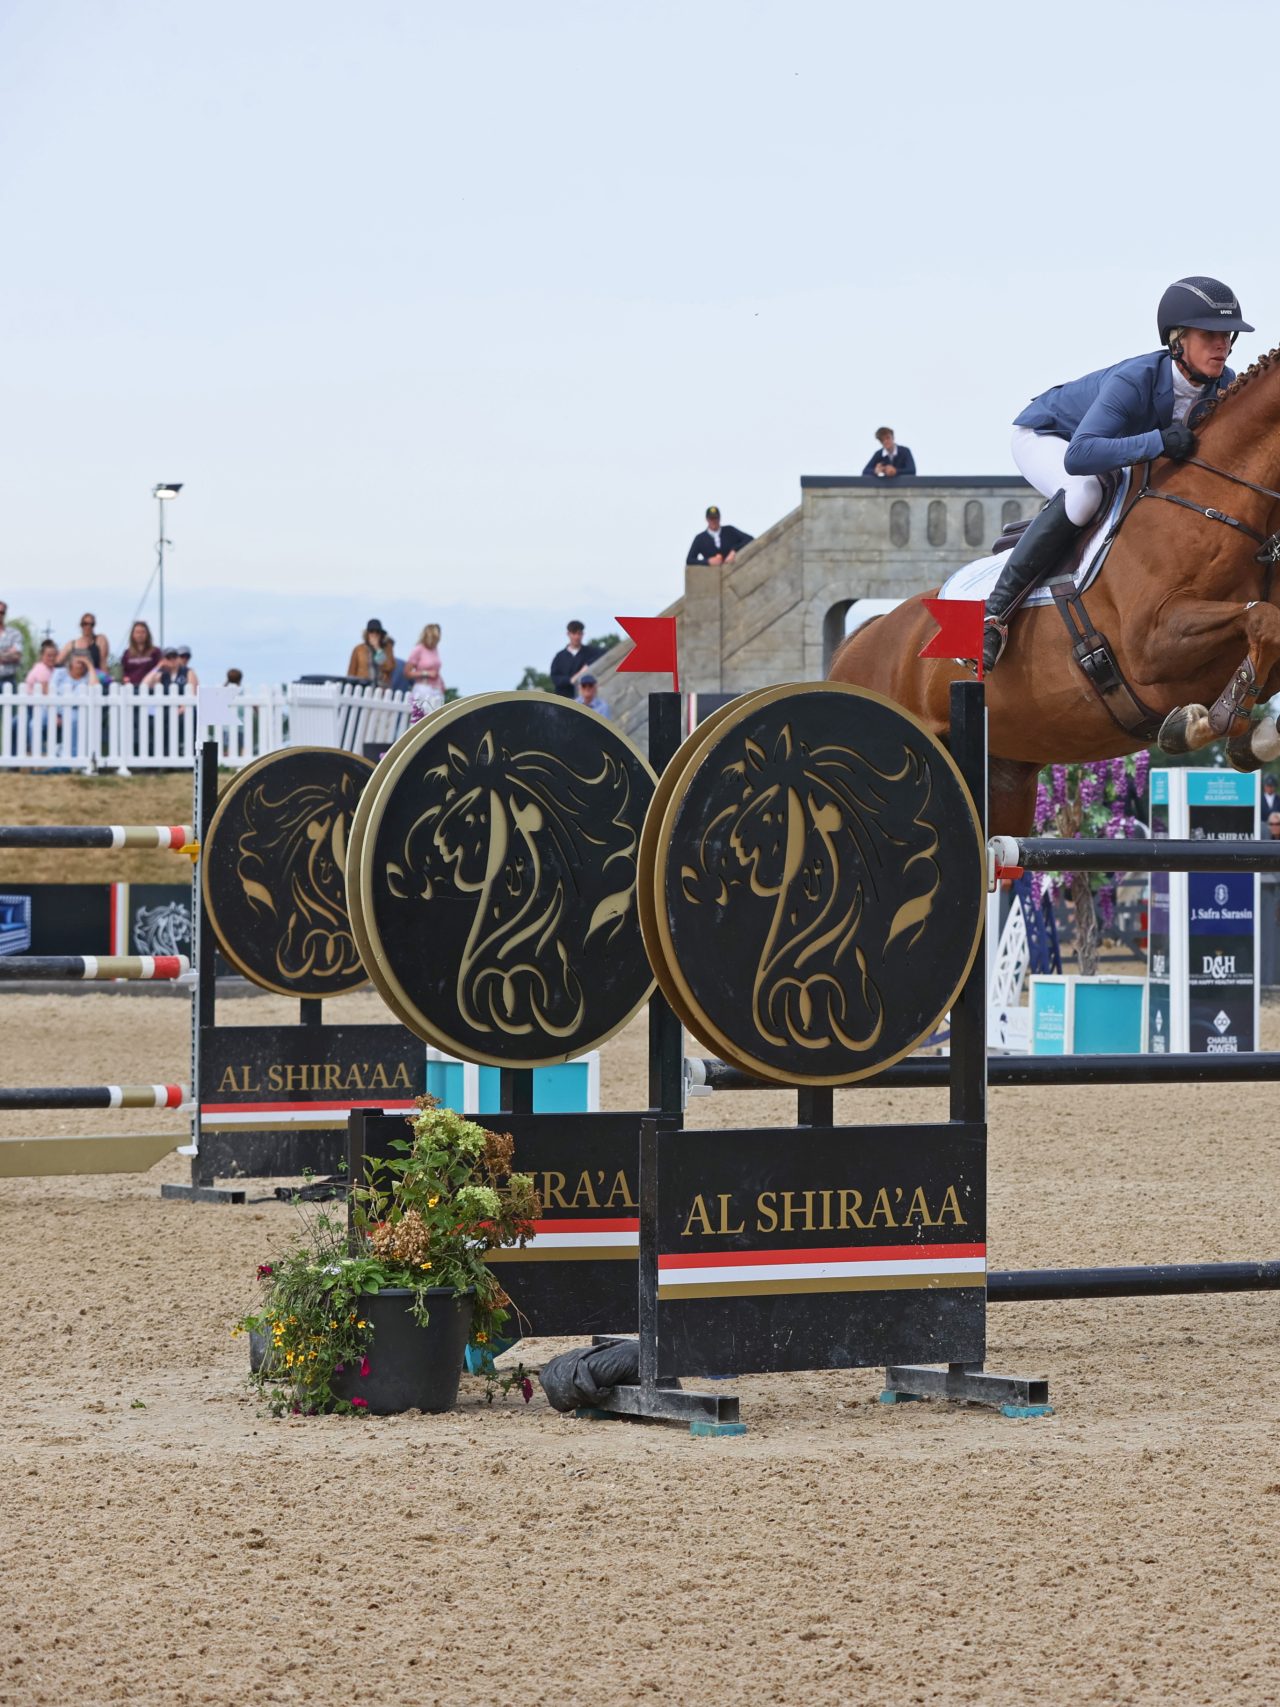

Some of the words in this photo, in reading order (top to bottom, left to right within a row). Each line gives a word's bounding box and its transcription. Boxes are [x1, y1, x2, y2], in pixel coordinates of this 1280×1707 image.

[1198, 908, 1220, 919] Safra
[1221, 908, 1253, 919] Sarasin
[1202, 955, 1236, 979] D&H
[1206, 1036, 1238, 1045] CHARLES
[1206, 1044, 1238, 1053] OWEN
[217, 1065, 261, 1092] AL
[267, 1061, 413, 1092] SHIRA'AA
[680, 1193, 746, 1236] AL
[756, 1184, 968, 1233] SHIRA'AA
